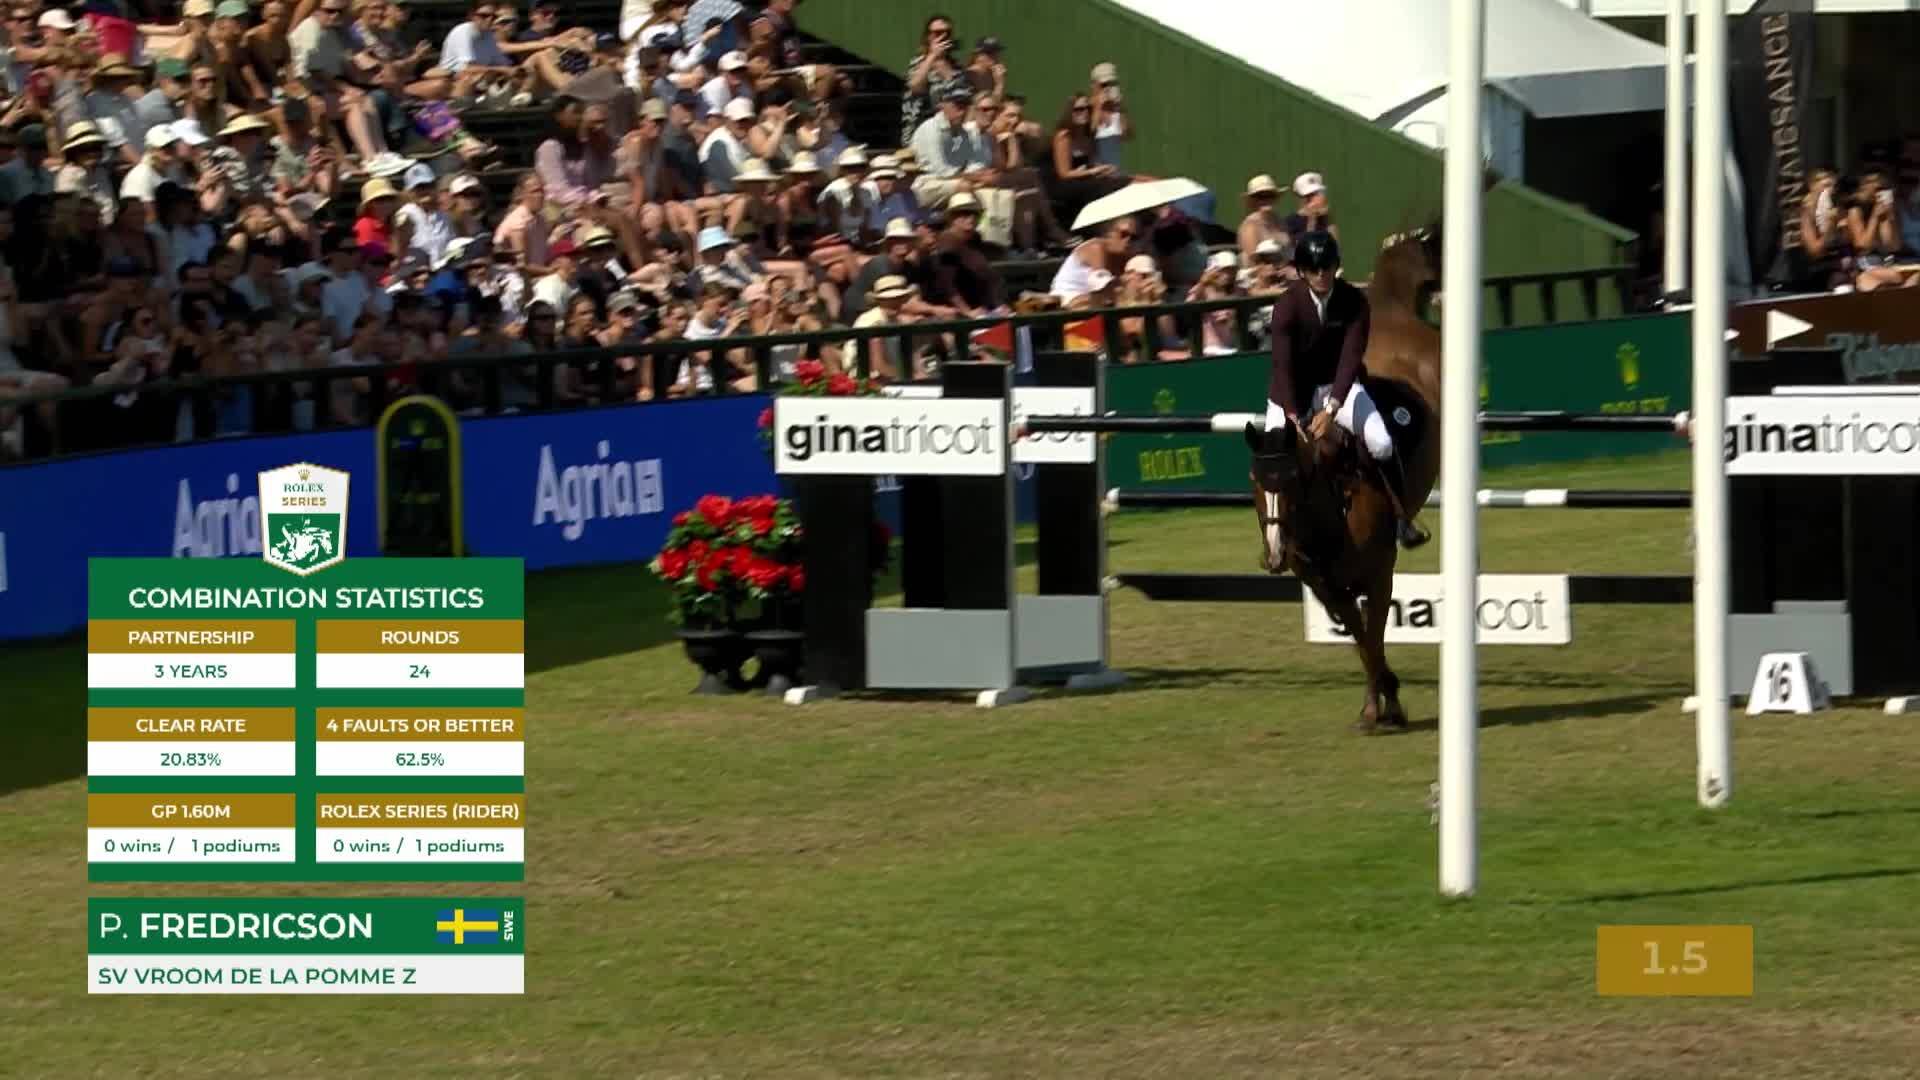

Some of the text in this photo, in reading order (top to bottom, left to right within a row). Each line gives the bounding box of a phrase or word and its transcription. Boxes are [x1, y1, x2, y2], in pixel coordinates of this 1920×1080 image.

[1723, 412, 1920, 464] ginatrico
[1138, 446, 1206, 481] ROLEX
[532, 439, 633, 542] Agria
[1765, 661, 1793, 703] 16
